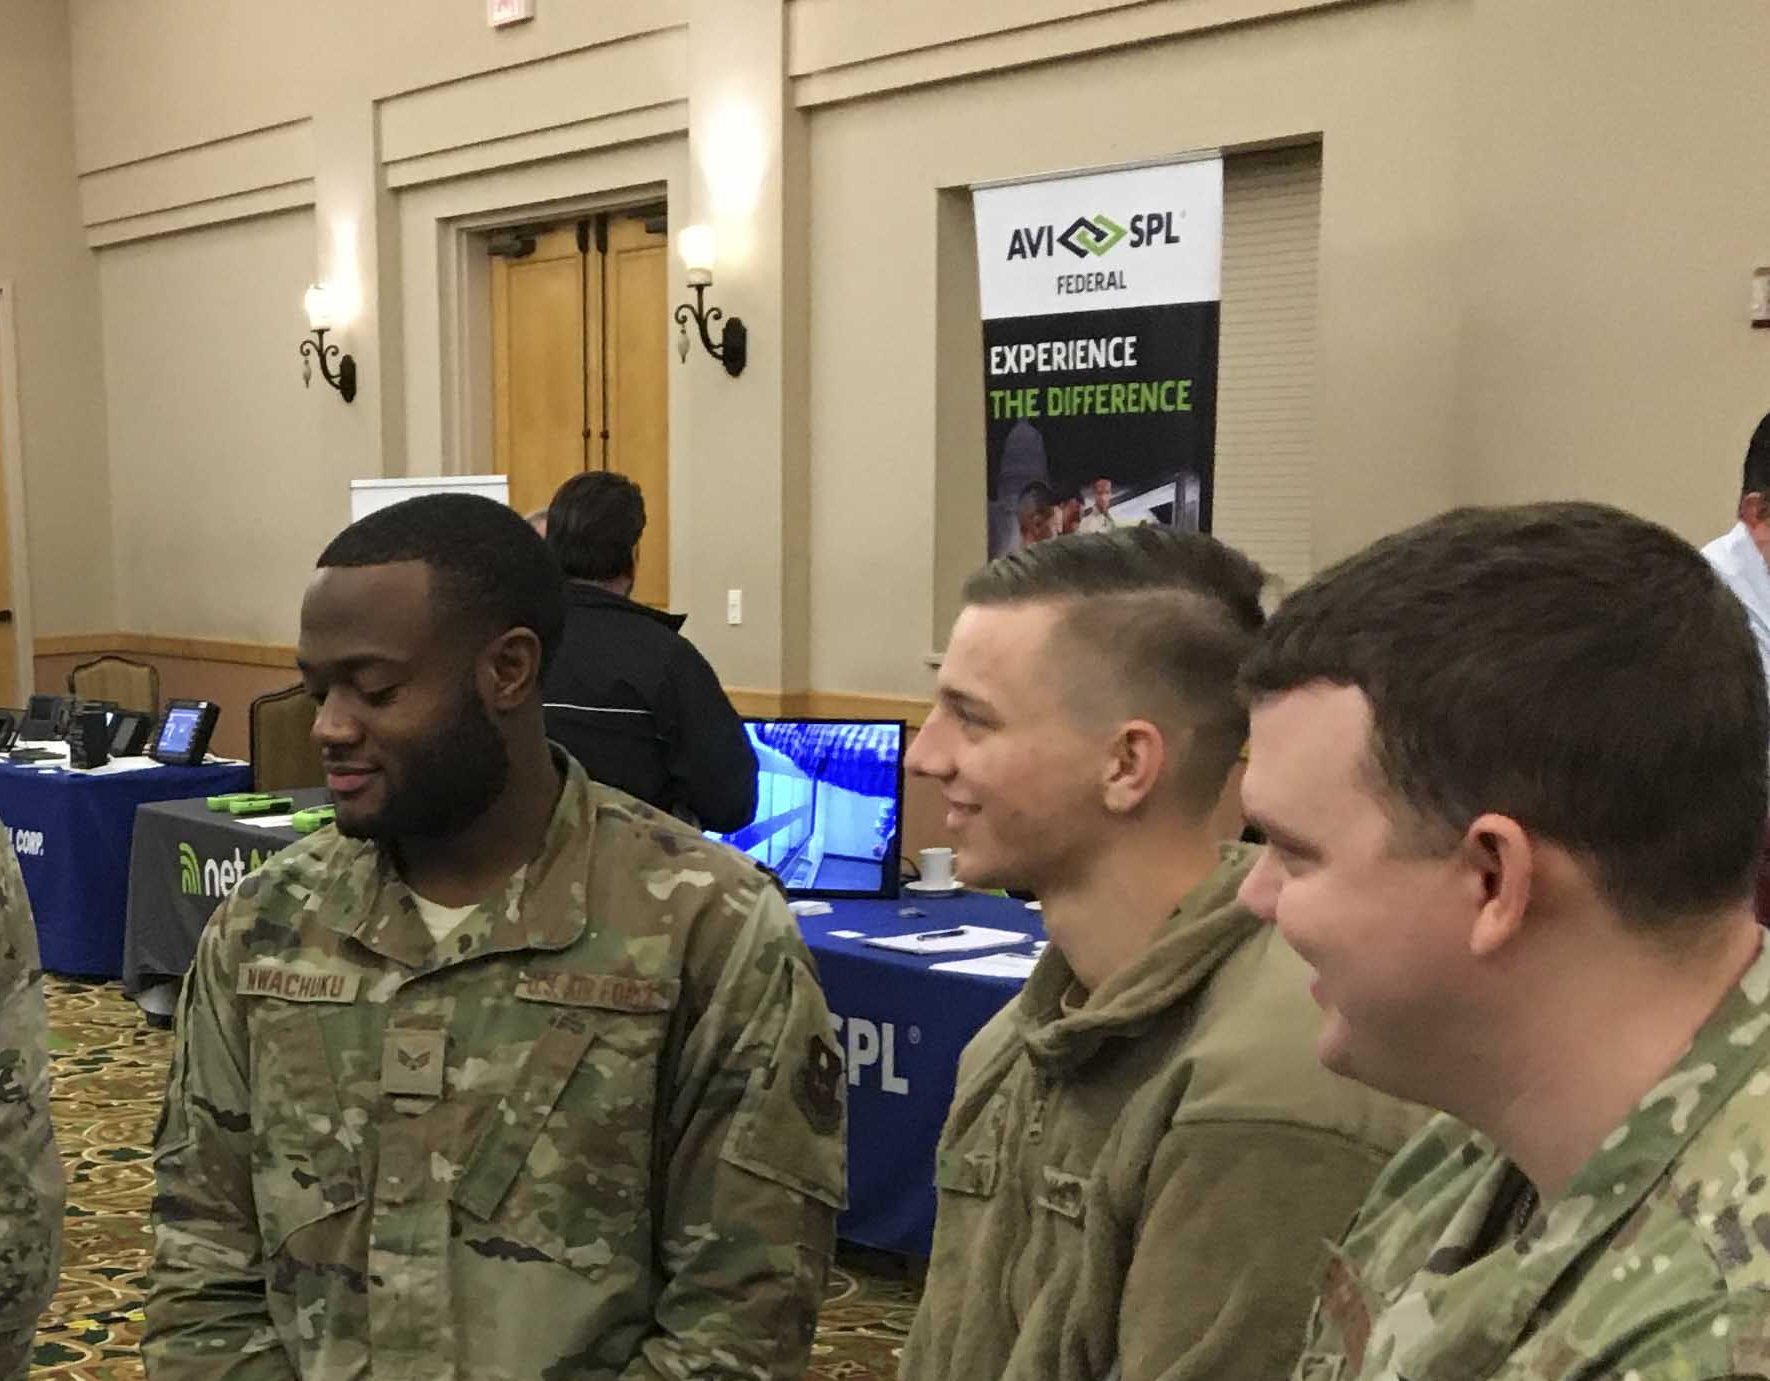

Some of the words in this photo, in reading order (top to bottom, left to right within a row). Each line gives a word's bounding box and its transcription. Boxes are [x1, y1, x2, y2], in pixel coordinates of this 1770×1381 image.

[1006, 226, 1054, 261] AVI
[1130, 211, 1181, 248] SPL
[1056, 270, 1127, 295] FEDERAL
[990, 336, 1137, 375] EXPERIENCE
[990, 387, 1039, 419] THE
[1047, 379, 1191, 417] DIFFERENCE
